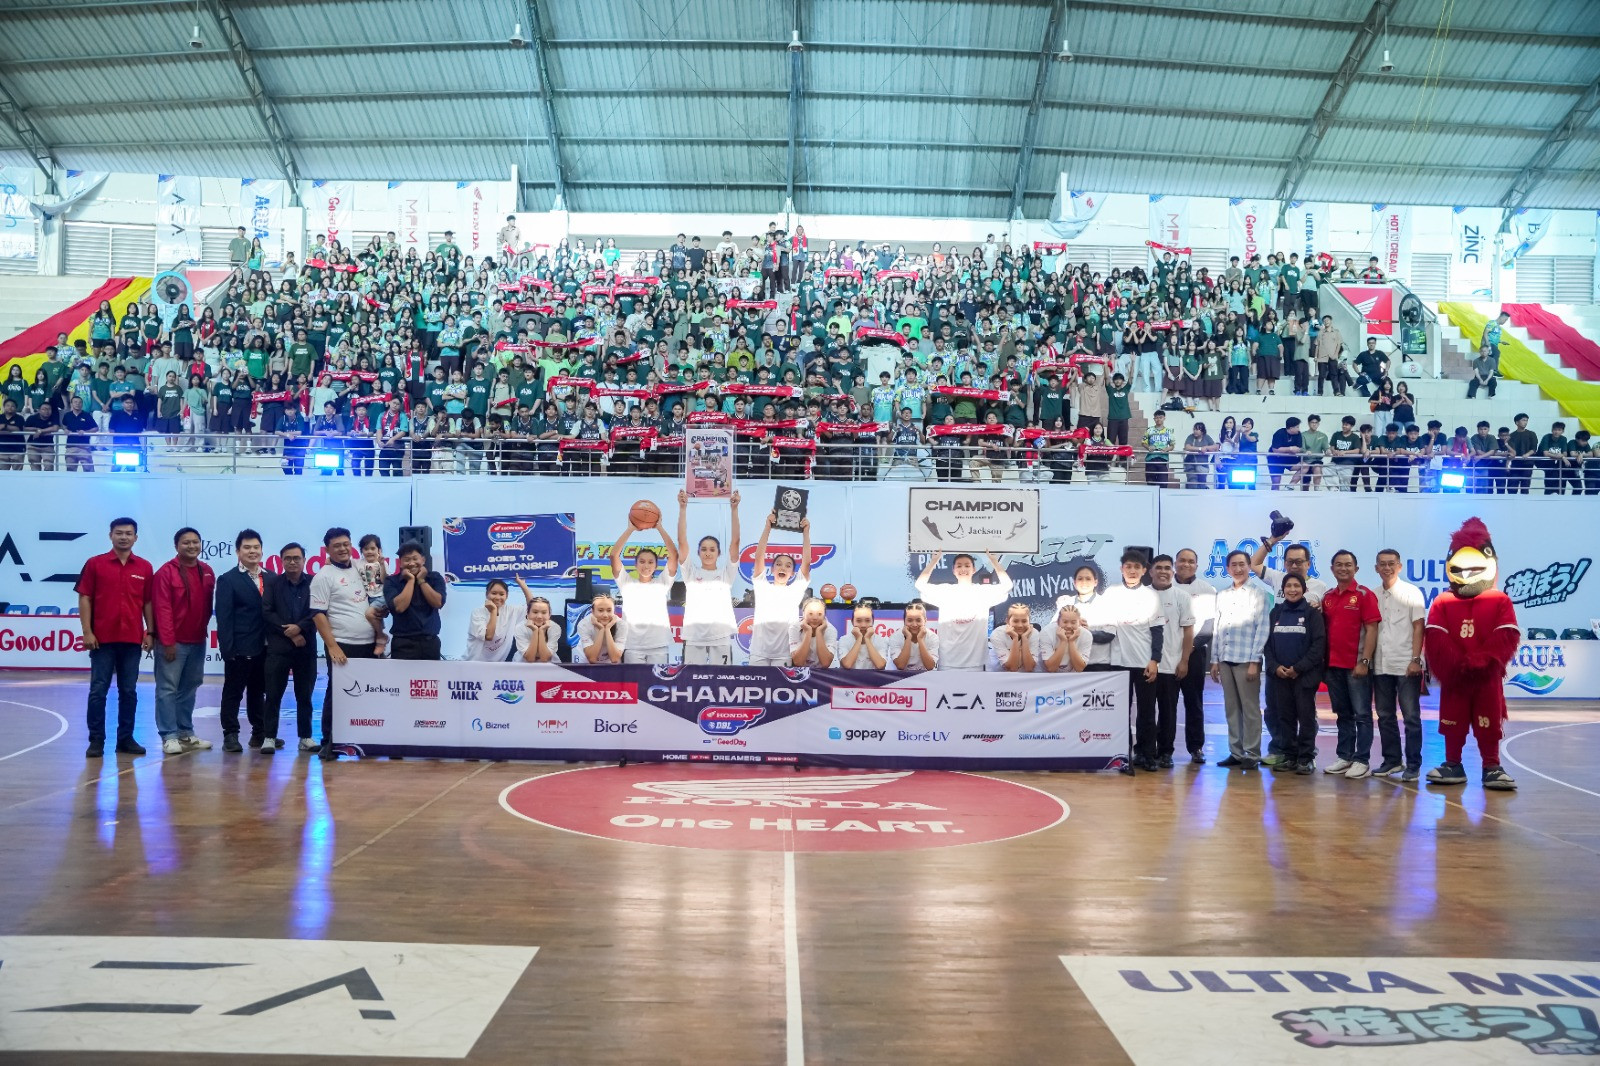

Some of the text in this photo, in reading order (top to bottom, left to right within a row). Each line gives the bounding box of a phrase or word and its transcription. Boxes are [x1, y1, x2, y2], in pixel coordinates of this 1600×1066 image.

[1305, 213, 1314, 242] ULTRA
[1390, 214, 1399, 232] HOT
[1463, 224, 1480, 264] ZINC
[1388, 242, 1399, 273] CREAM
[925, 500, 1024, 513] CHAMPION
[968, 526, 1002, 535] Jackson
[463, 560, 559, 574] CHAMPIONSHIP
[1460, 623, 1475, 638] 89
[364, 684, 400, 693] Jackson
[410, 679, 428, 688] HOT
[447, 681, 482, 691] ULTRA
[492, 679, 525, 692] AQUA
[410, 689, 438, 698] CREAM
[450, 692, 479, 701] MILK
[562, 690, 633, 700] HONDA
[646, 684, 819, 706] CHAMPION
[1082, 689, 1115, 707] ZINC
[995, 697, 1022, 707] Bioré
[1035, 690, 1073, 713] posh
[485, 721, 510, 729] Biznet
[537, 719, 568, 729] MPM
[594, 718, 638, 734] Bioré
[845, 728, 887, 741] gopay
[897, 730, 951, 742] Bioré UV
[622, 796, 948, 811] HONDA
[609, 814, 966, 833] One HEART.
[1117, 970, 1446, 995] ULTRA
